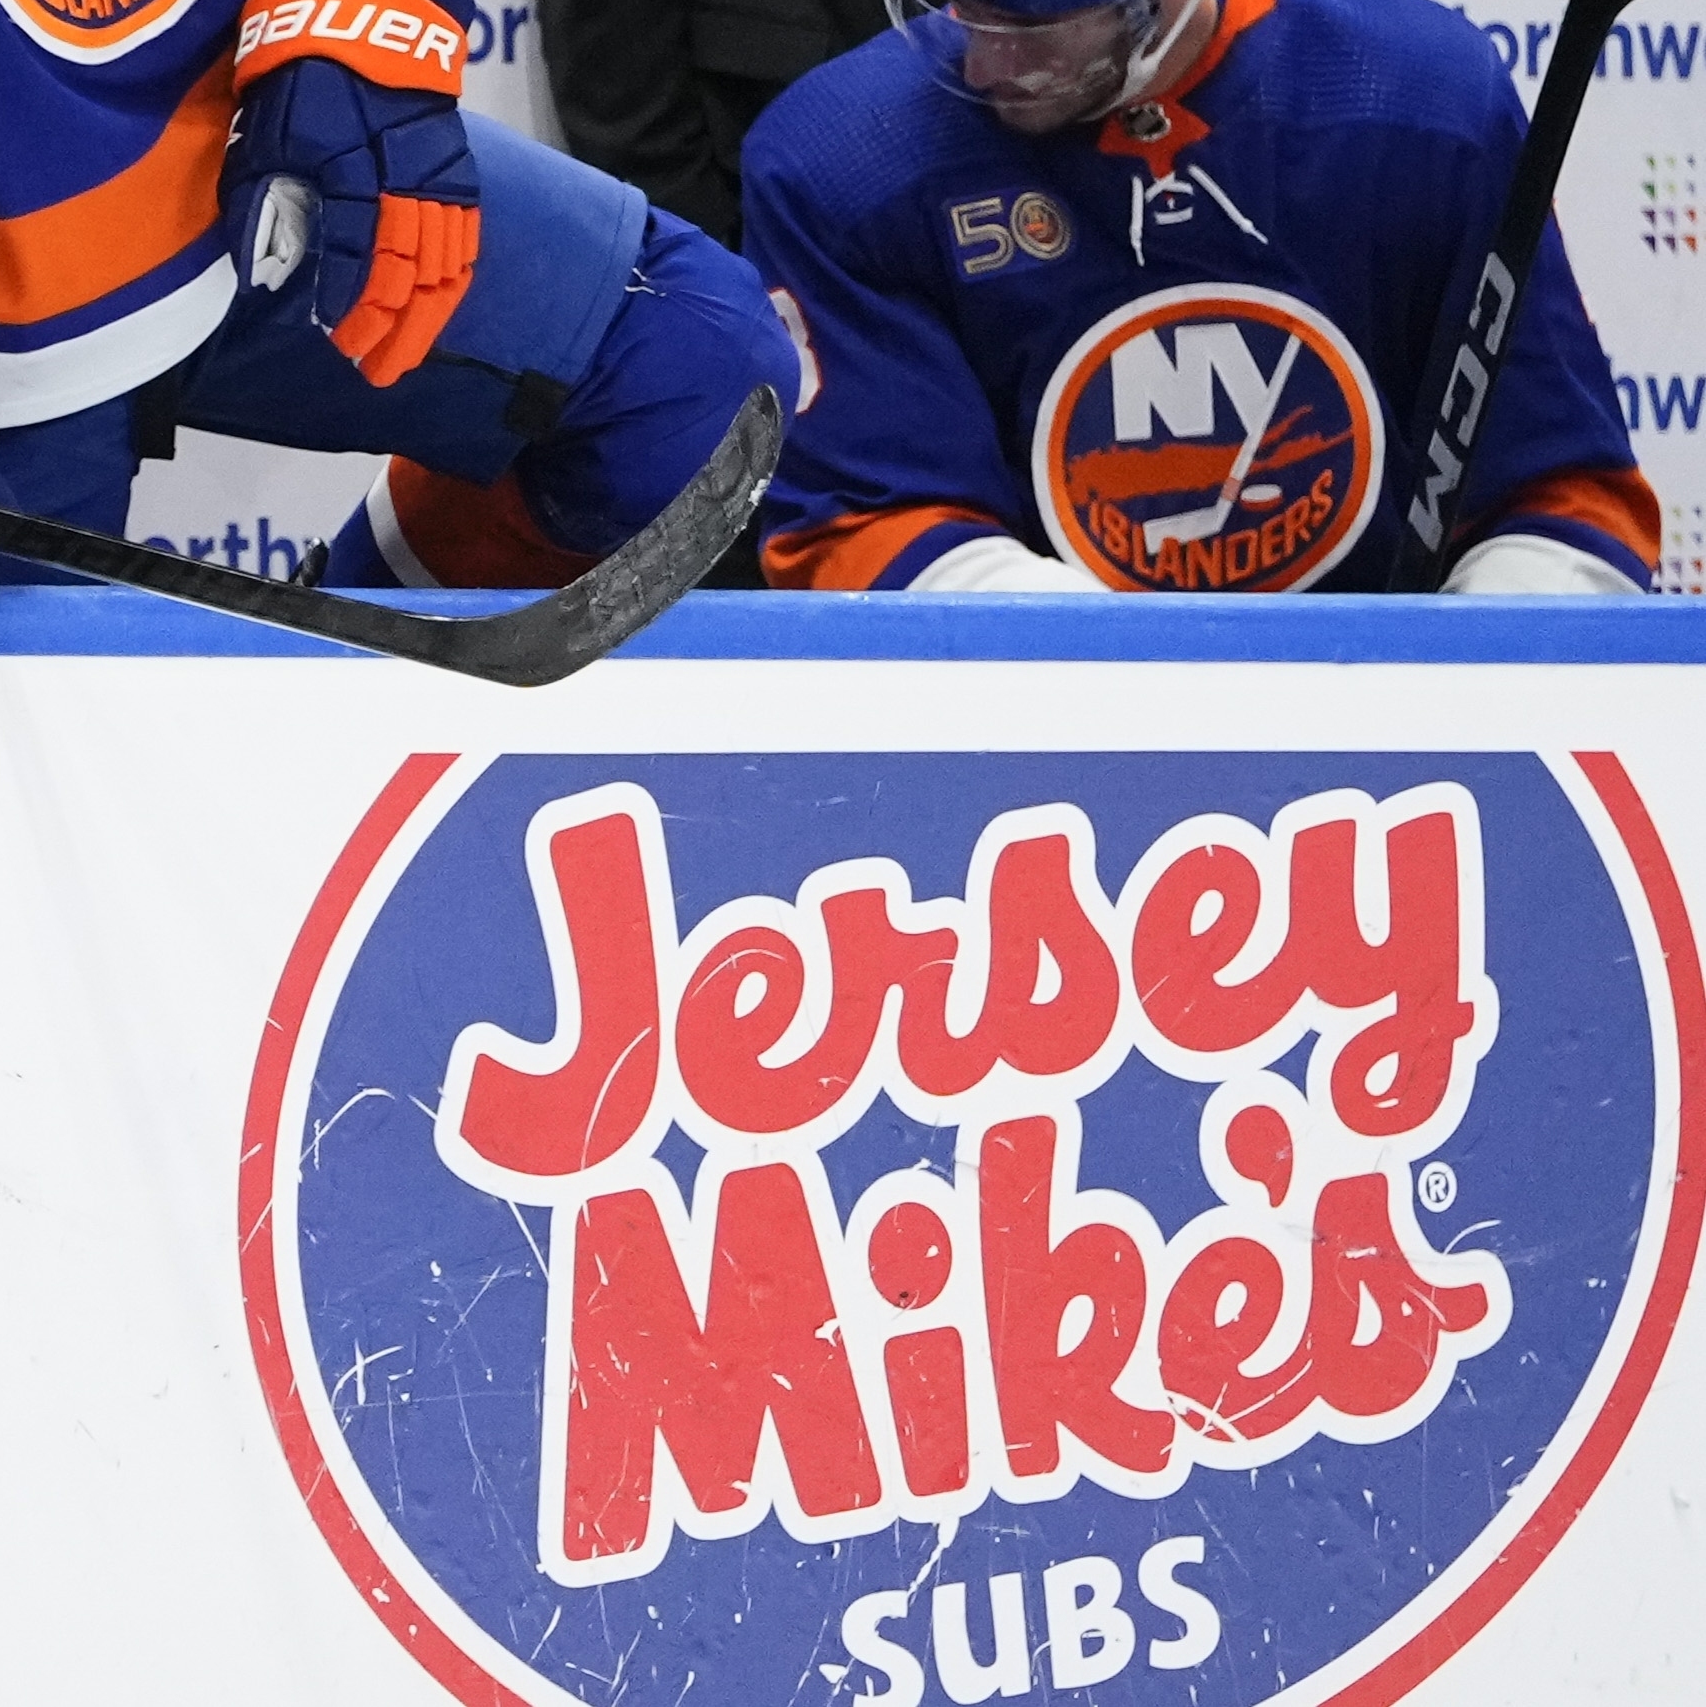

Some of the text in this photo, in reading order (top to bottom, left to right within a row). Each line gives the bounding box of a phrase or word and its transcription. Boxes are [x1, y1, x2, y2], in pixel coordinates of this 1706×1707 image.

[950, 192, 1072, 275] 50
[1109, 321, 1303, 444] NY
[1409, 251, 1517, 554] CCM
[1086, 470, 1336, 592] ISLANDERS
[453, 804, 1479, 1180] Jersey
[839, 1535, 1221, 1707] SUBS
